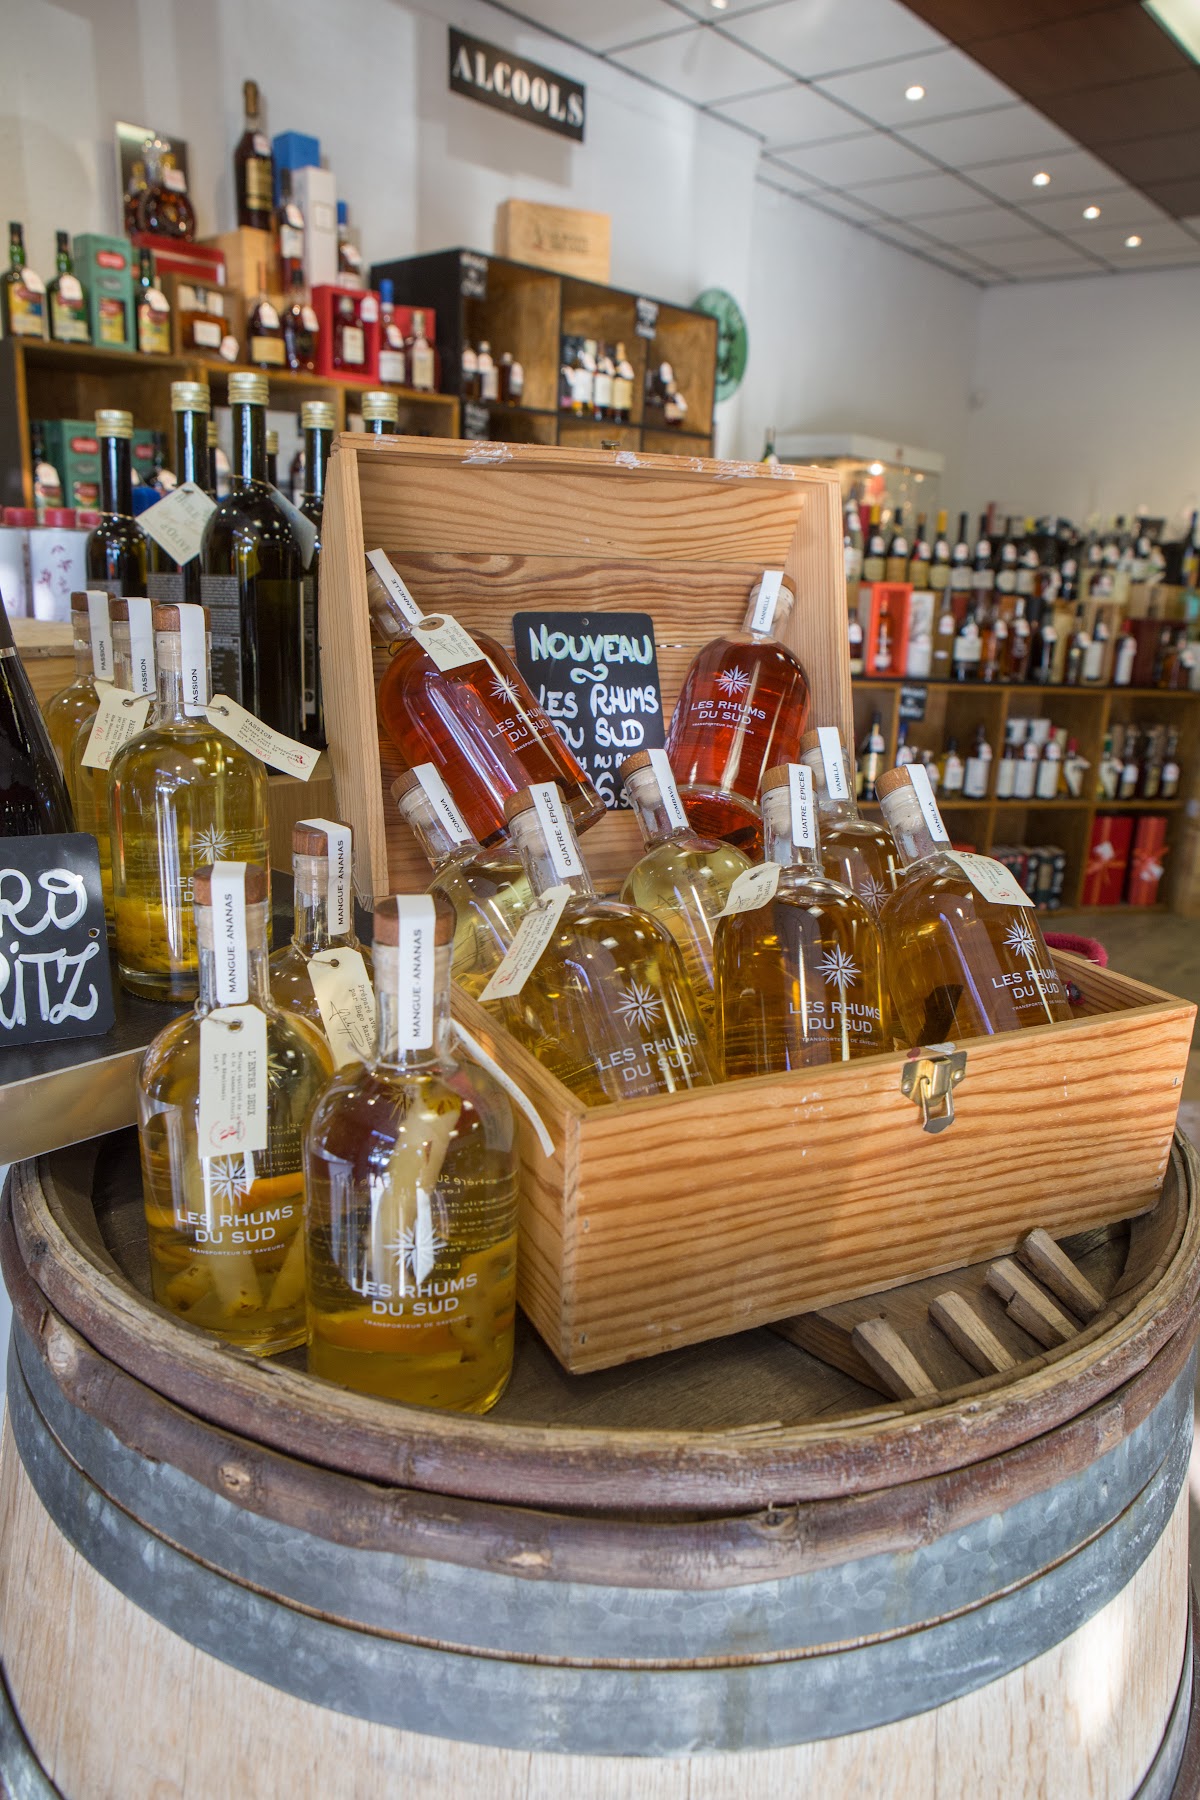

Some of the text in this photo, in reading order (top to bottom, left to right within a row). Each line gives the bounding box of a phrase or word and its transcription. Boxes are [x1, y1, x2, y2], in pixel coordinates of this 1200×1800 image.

[453, 46, 583, 127] ALCOOLS
[391, 578, 417, 615] CANNELLE
[760, 595, 771, 625] CANNELLE
[529, 624, 653, 664] NOUVEAU
[539, 683, 659, 719] LES RHUMS
[691, 700, 766, 720] LES RHUMS
[245, 718, 273, 740] PASSION
[488, 718, 515, 738] LES
[553, 717, 644, 748] DU SUD
[699, 710, 752, 725] DU SUD
[508, 726, 528, 742] DU
[440, 798, 463, 833] COMBAVA
[666, 785, 683, 820] COMBAVA
[928, 801, 943, 834] VANILLA
[800, 805, 809, 839] QUATRE
[555, 830, 572, 867] QUATRE
[224, 893, 237, 993] MANGUE ANANAS
[413, 929, 422, 1038] MANGUE ANANAS
[992, 972, 1023, 989] LES
[1012, 983, 1059, 999] DU SUD
[789, 1001, 881, 1020] LES RHUMS
[808, 1017, 873, 1034] DU SUD
[597, 1033, 698, 1070] LES RHUMS
[622, 1052, 692, 1082] DU SUD
[246, 1049, 256, 1116] L'ENTRE DEUX
[176, 1205, 294, 1227] LES RHUMS
[195, 1227, 276, 1244] DU SUD
[351, 1273, 478, 1299] LES RHUMS
[372, 1297, 460, 1316] DU SUD
